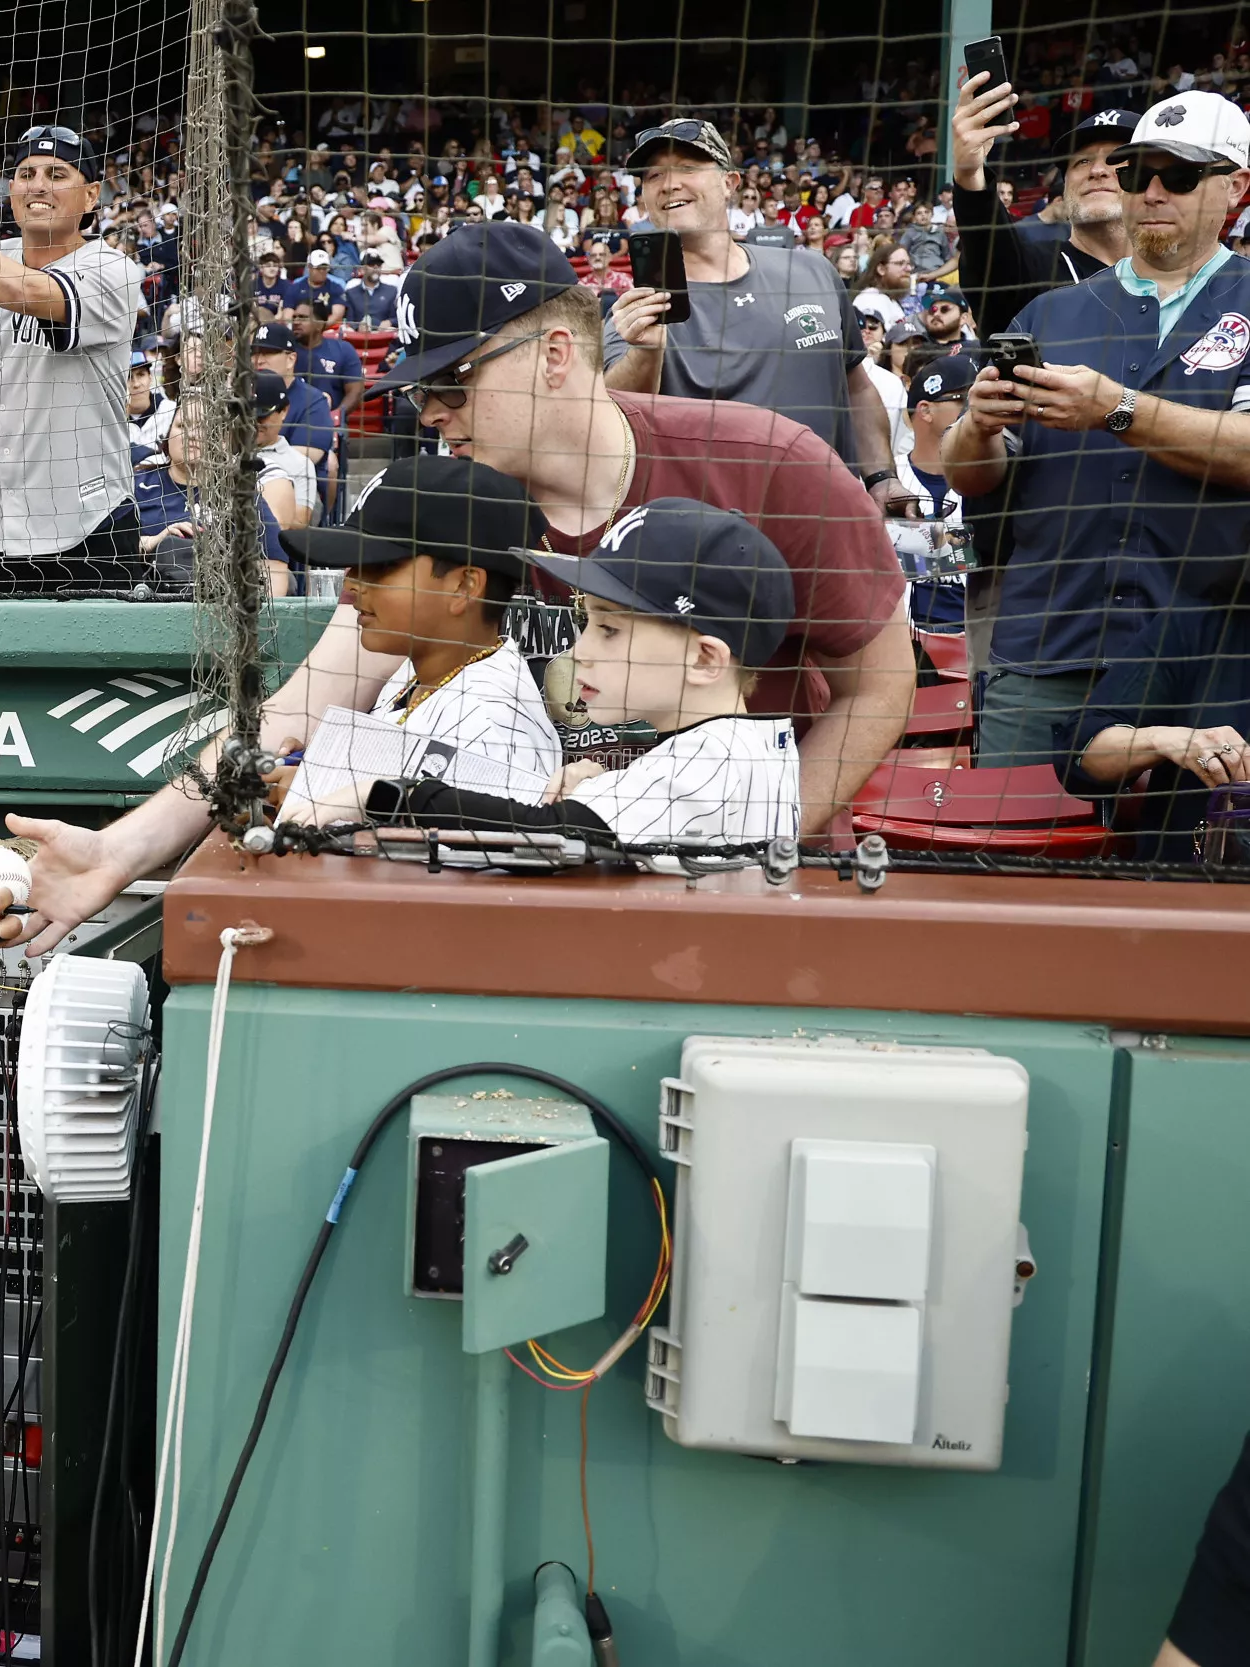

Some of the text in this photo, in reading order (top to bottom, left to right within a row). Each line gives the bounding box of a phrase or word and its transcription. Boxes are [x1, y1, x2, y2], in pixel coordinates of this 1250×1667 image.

[783, 304, 826, 325] ABINGTON
[795, 330, 839, 350] FOOTBALL
[565, 727, 619, 748] 2023
[933, 787, 944, 801] 2
